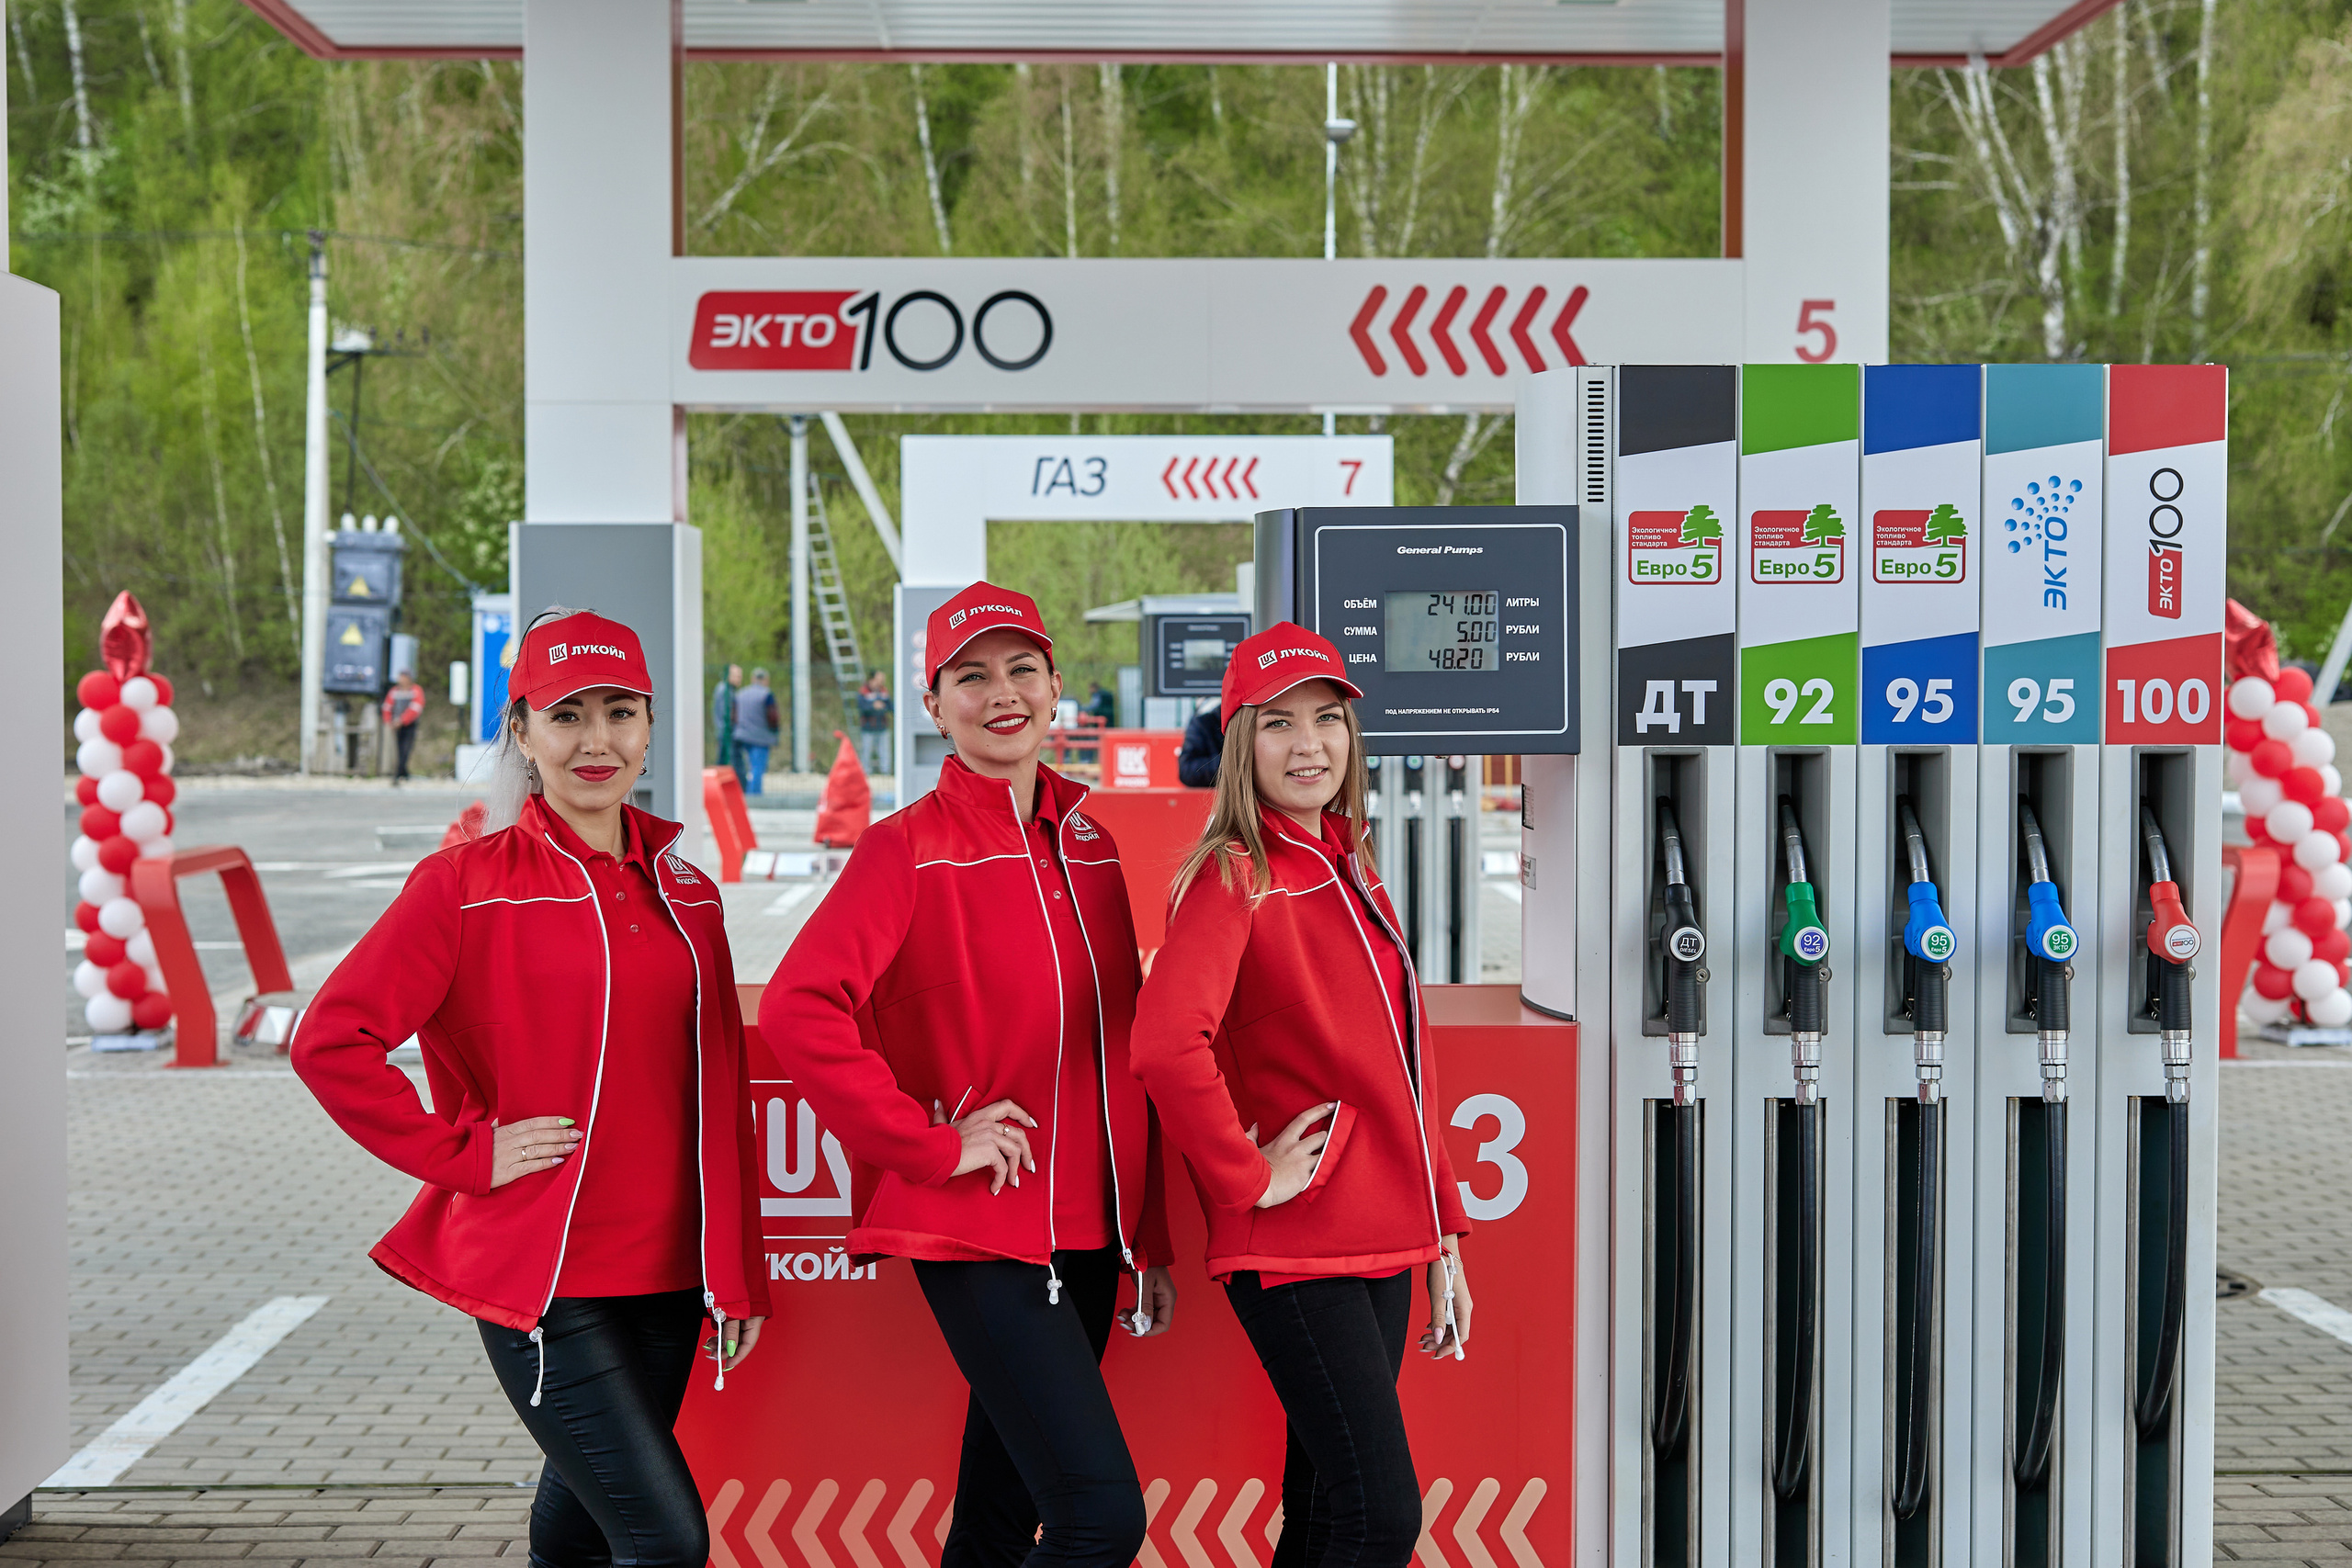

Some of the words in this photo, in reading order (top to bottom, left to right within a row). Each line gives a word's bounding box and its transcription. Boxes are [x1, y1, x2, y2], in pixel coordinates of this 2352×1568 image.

[709, 313, 836, 348] ЭКТО
[848, 289, 1054, 372] 100
[1794, 299, 1838, 364] 5
[1032, 457, 1108, 496] ГАЗ
[1340, 460, 1363, 495] 7
[2149, 468, 2184, 553] 100
[1396, 546, 1442, 555] General
[1443, 546, 1484, 556] Pumps
[2044, 516, 2067, 610] ЭКТО
[1636, 559, 1688, 580] Евро
[1690, 554, 1714, 579] 5
[1759, 558, 1810, 579] Евро
[1813, 553, 1837, 578] 5
[1881, 558, 1932, 579] Евро
[1934, 553, 1959, 578] 5
[2159, 558, 2173, 610] ЭКТО
[969, 604, 1023, 617] ЛУКОЙЛ
[1343, 597, 1377, 610] ОБЪЁМ
[1506, 598, 1540, 608] ЛИТРЫ
[1343, 626, 1378, 637] СУММА
[1456, 620, 1498, 643] 5.00
[1506, 625, 1540, 636] РУБЛИ
[571, 644, 627, 661] ЛУКОЙЛ
[1280, 648, 1330, 663] ЛУКОЙЛ
[1349, 654, 1378, 665] ЦЕНА
[1429, 648, 1484, 670] 48.20
[1506, 652, 1540, 662] РУБЛИ
[1635, 680, 1717, 734] ДТ
[1764, 678, 1836, 726] 92
[1885, 678, 1955, 725] 95
[2007, 678, 2076, 725] 95
[2117, 678, 2212, 726] 100
[1679, 937, 1698, 948] ДТ
[1804, 934, 1821, 946] 92
[1815, 945, 1821, 953] 5
[1930, 934, 1948, 946] 95
[2052, 933, 2069, 945] 95
[1450, 1093, 1529, 1221] 3
[766, 1246, 877, 1282] КОЙЛ
